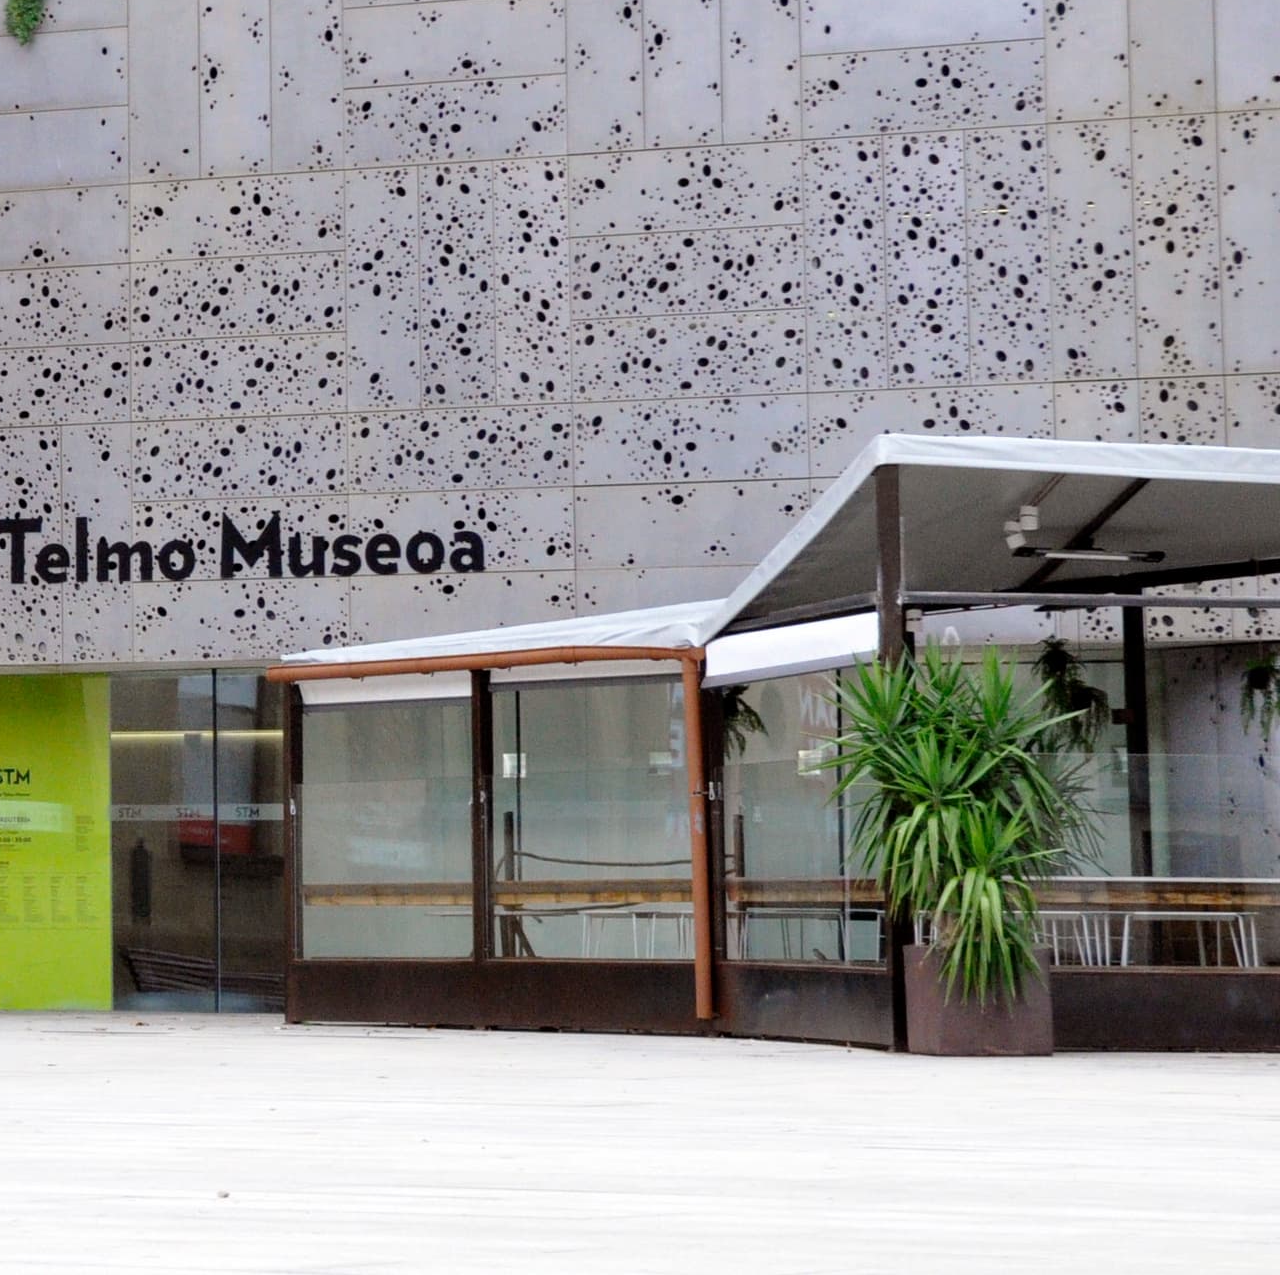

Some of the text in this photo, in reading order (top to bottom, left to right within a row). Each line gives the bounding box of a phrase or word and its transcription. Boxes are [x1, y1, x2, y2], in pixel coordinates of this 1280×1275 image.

[220, 509, 487, 579] Museoa
[118, 807, 141, 818] STM
[235, 806, 260, 818] STM
